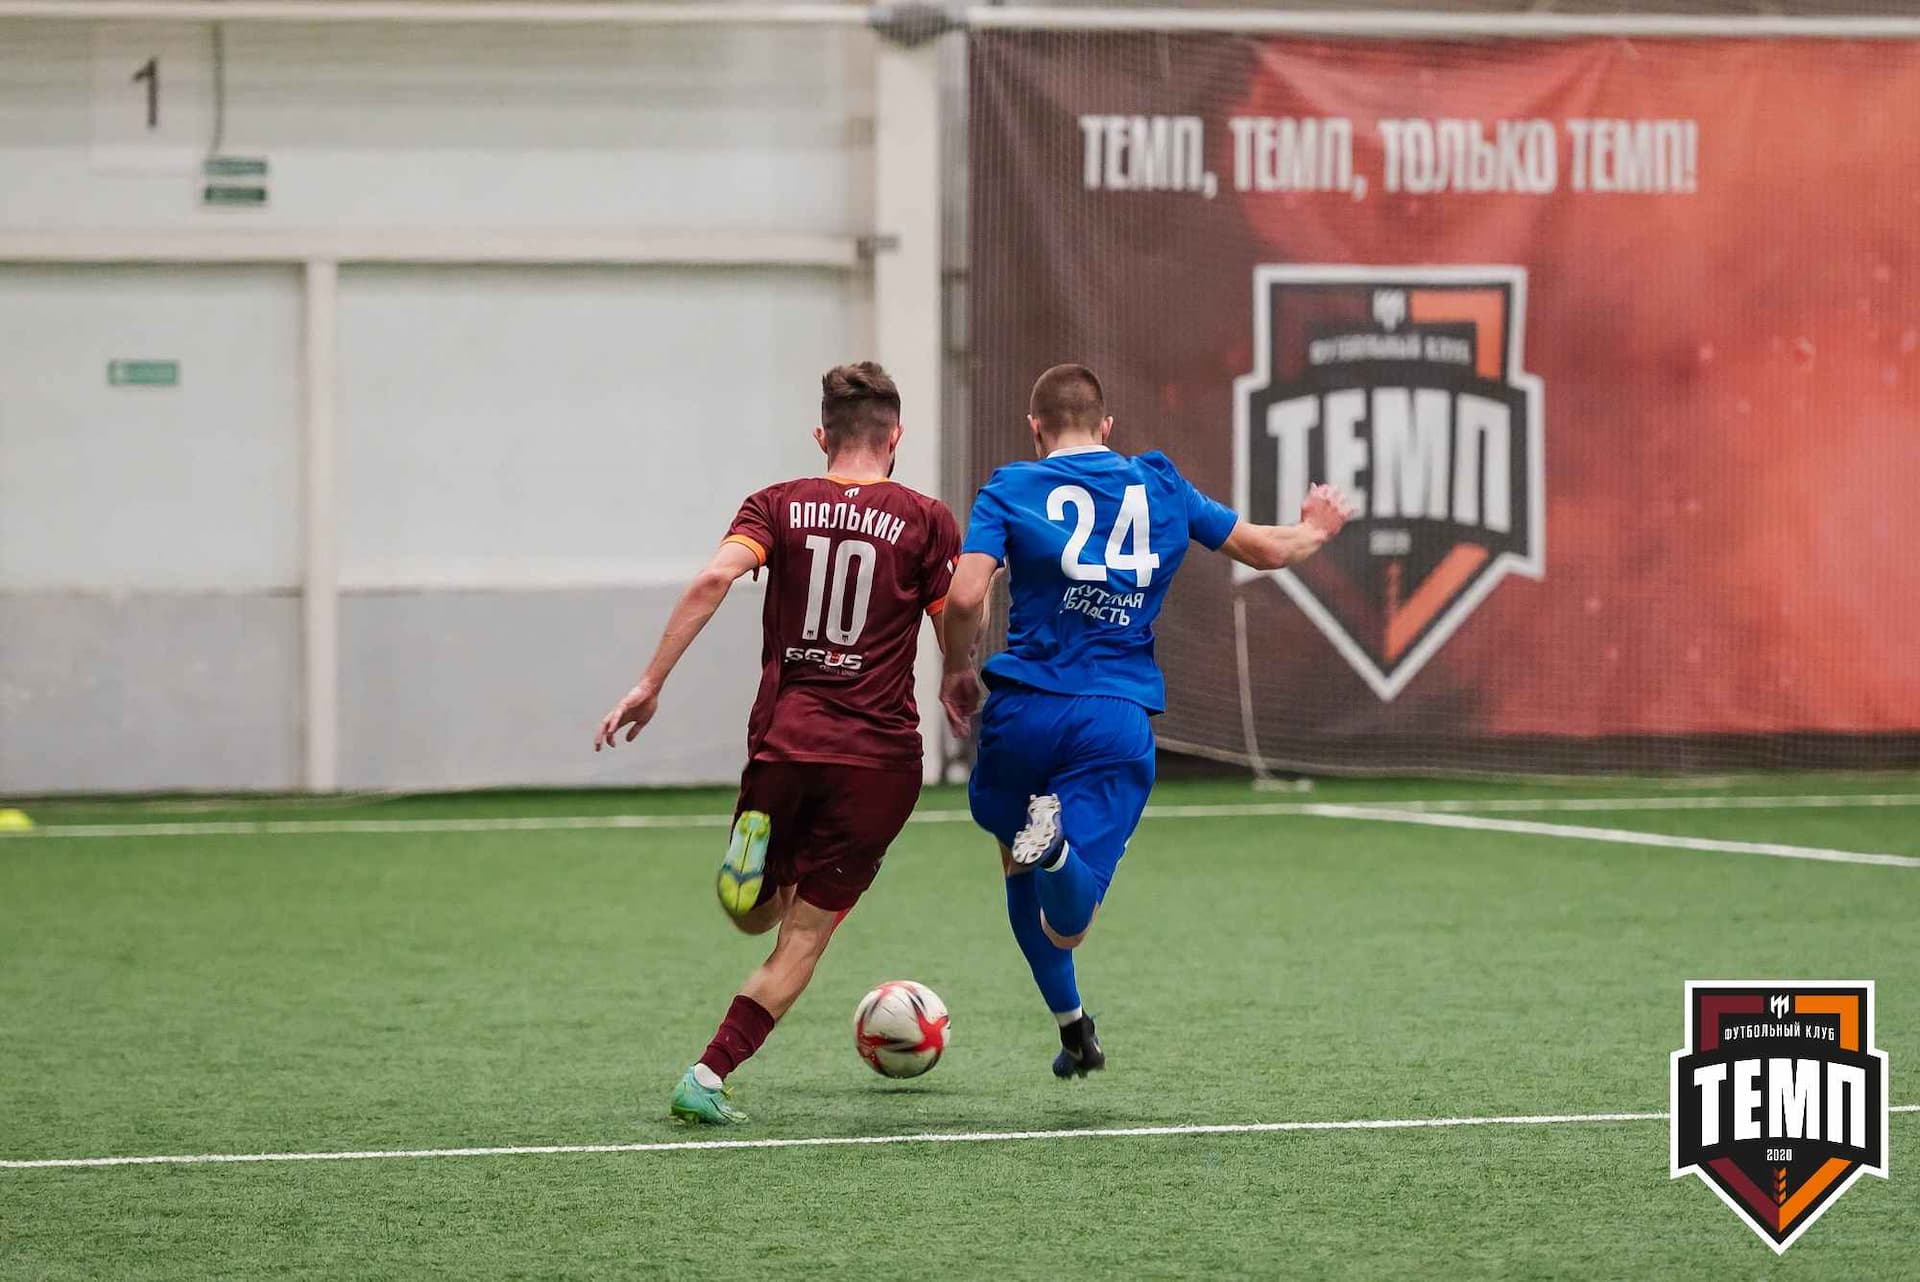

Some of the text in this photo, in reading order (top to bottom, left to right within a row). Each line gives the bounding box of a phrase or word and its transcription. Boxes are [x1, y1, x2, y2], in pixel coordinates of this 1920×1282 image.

[132, 59, 157, 127] 1
[1080, 115, 1697, 200] ТЕМП, ТЕМП, ТОЛЬКО ТЕМП!
[1267, 386, 1511, 533] ТЕМП
[789, 501, 906, 545] АПАЛЬКИН
[1046, 484, 1160, 587] 24
[802, 534, 877, 646] 10
[1059, 597, 1131, 626] БЛАСТЬ
